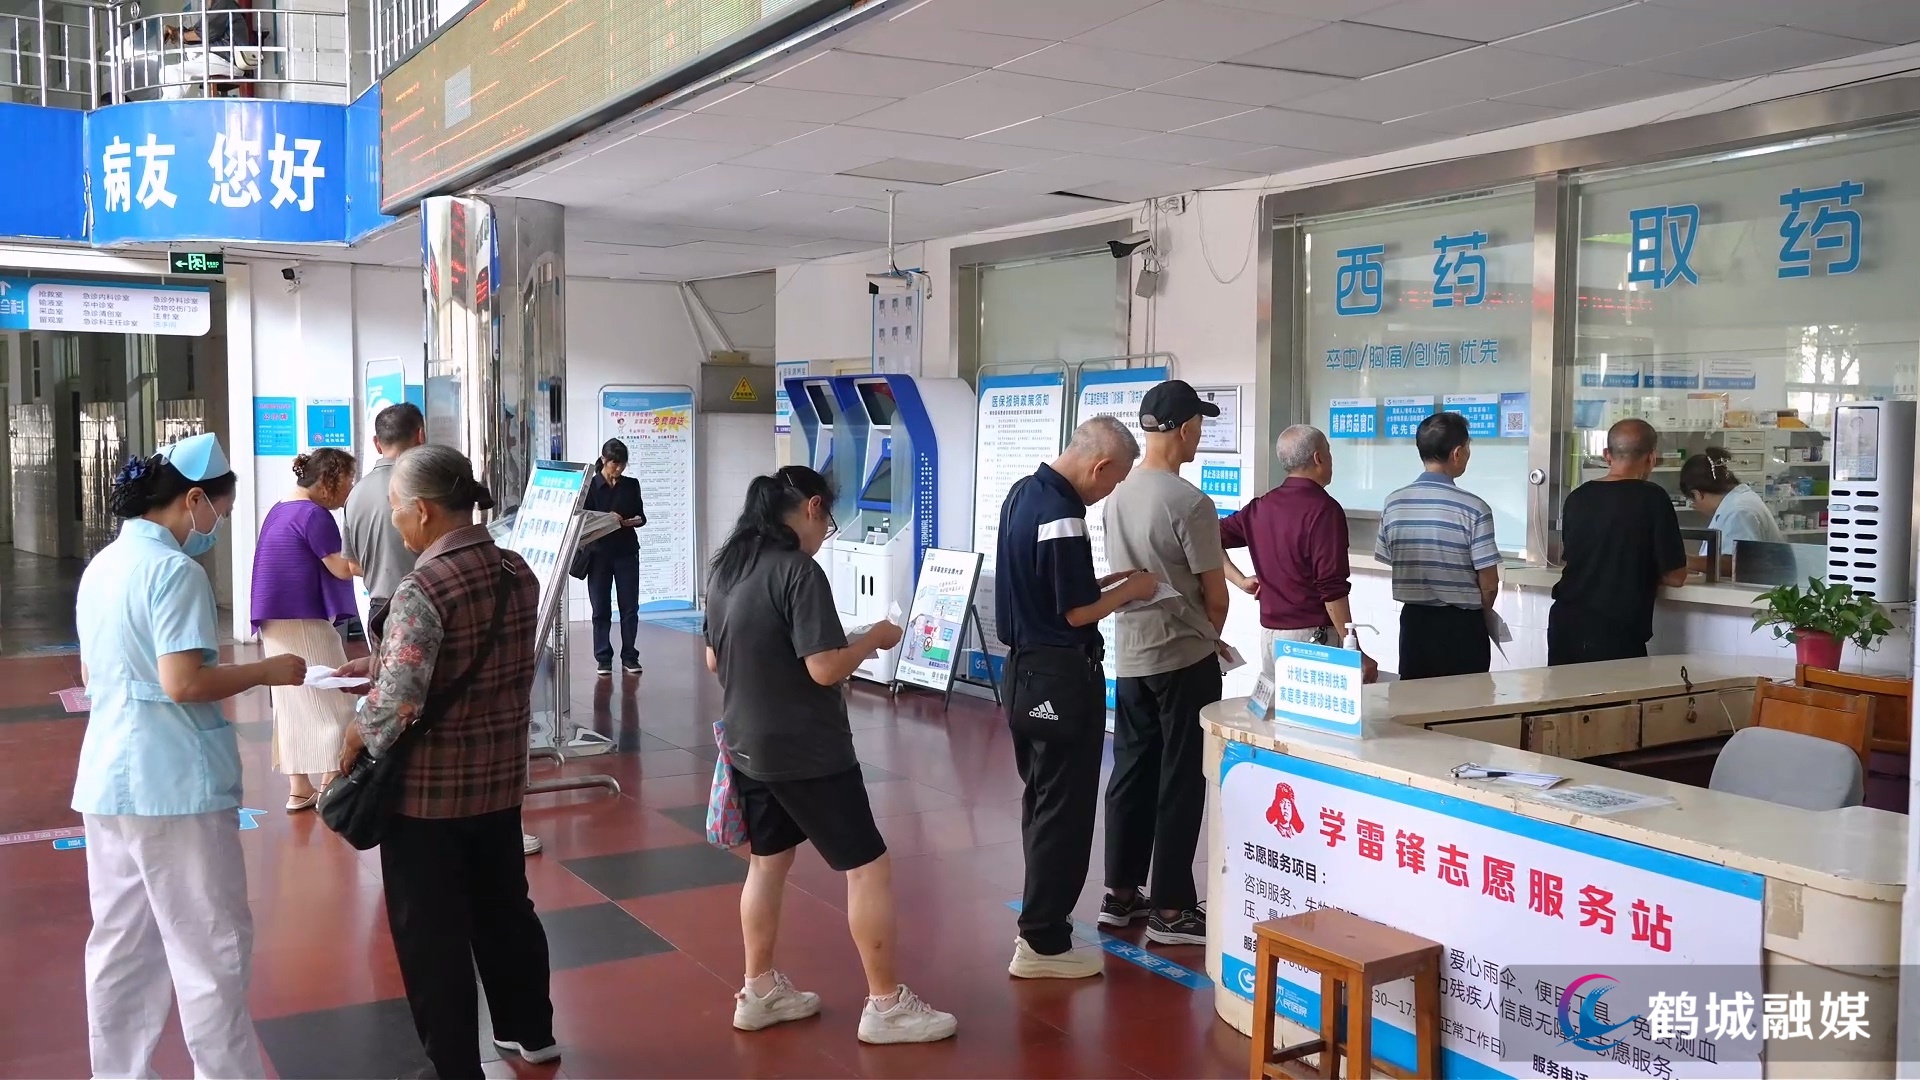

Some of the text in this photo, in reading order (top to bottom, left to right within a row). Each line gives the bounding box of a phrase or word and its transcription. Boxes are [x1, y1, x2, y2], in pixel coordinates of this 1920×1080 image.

[103, 132, 326, 213] 病友 您好
[1627, 179, 1865, 291] 取药
[1335, 230, 1489, 316] 西药
[1326, 338, 1498, 371] 卒中/胸痛/创伤 优先
[1332, 413, 1374, 434] 精麻药品窗口
[1287, 665, 1348, 691] 计划生育特别扶助
[1028, 709, 1059, 721] adidas
[1280, 686, 1355, 716] 家庭患者就诊绿色通道
[1243, 841, 1328, 885] 志愿服务项目：
[1319, 806, 1673, 953] 学雷锋志愿服务站
